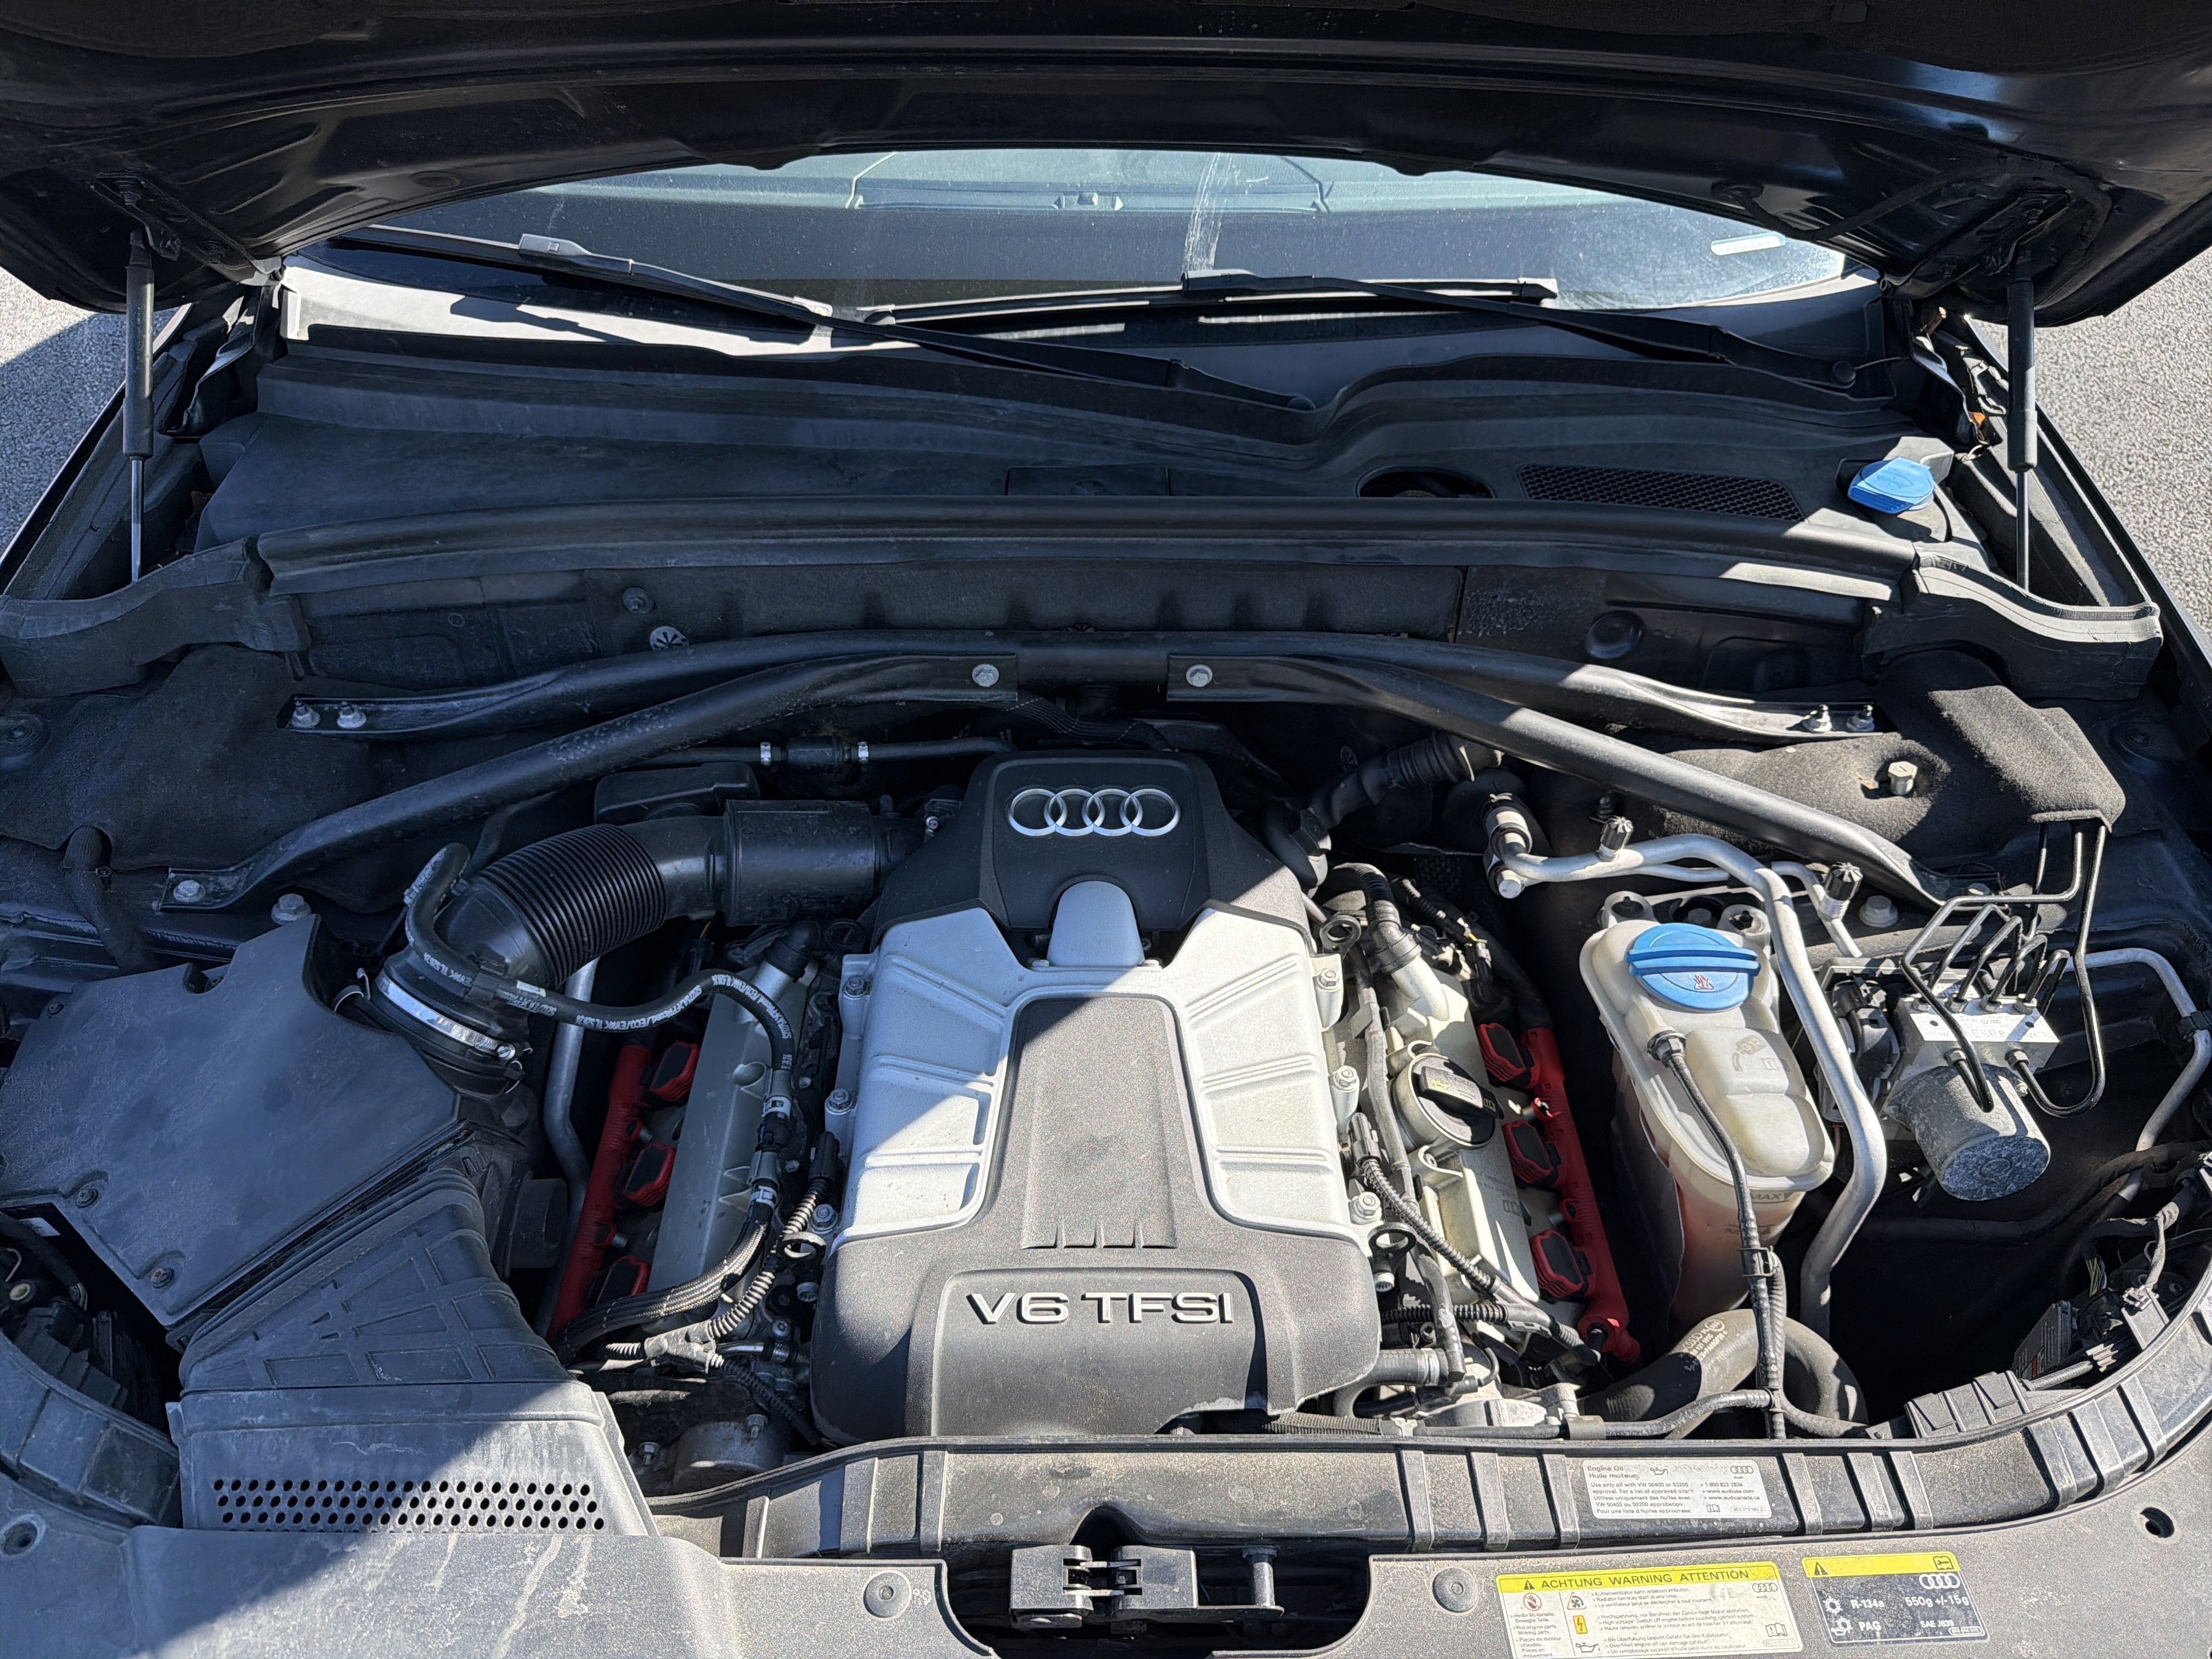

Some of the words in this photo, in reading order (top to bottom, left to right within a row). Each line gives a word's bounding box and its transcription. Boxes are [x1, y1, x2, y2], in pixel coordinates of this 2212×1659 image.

[966, 1291, 1069, 1325] V6
[1081, 1291, 1233, 1324] TFSI
[1541, 1578, 1602, 1589] ACHTUNG
[1609, 1574, 1673, 1585] WARNING
[1680, 1570, 1749, 1582] ATTENTION
[1850, 1599, 1884, 1609] R-134a
[1905, 1596, 1933, 1607] 550g
[1858, 1620, 1882, 1631] PAG
[1920, 1620, 1936, 1628] SAE
[1937, 1619, 1955, 1627] J639
